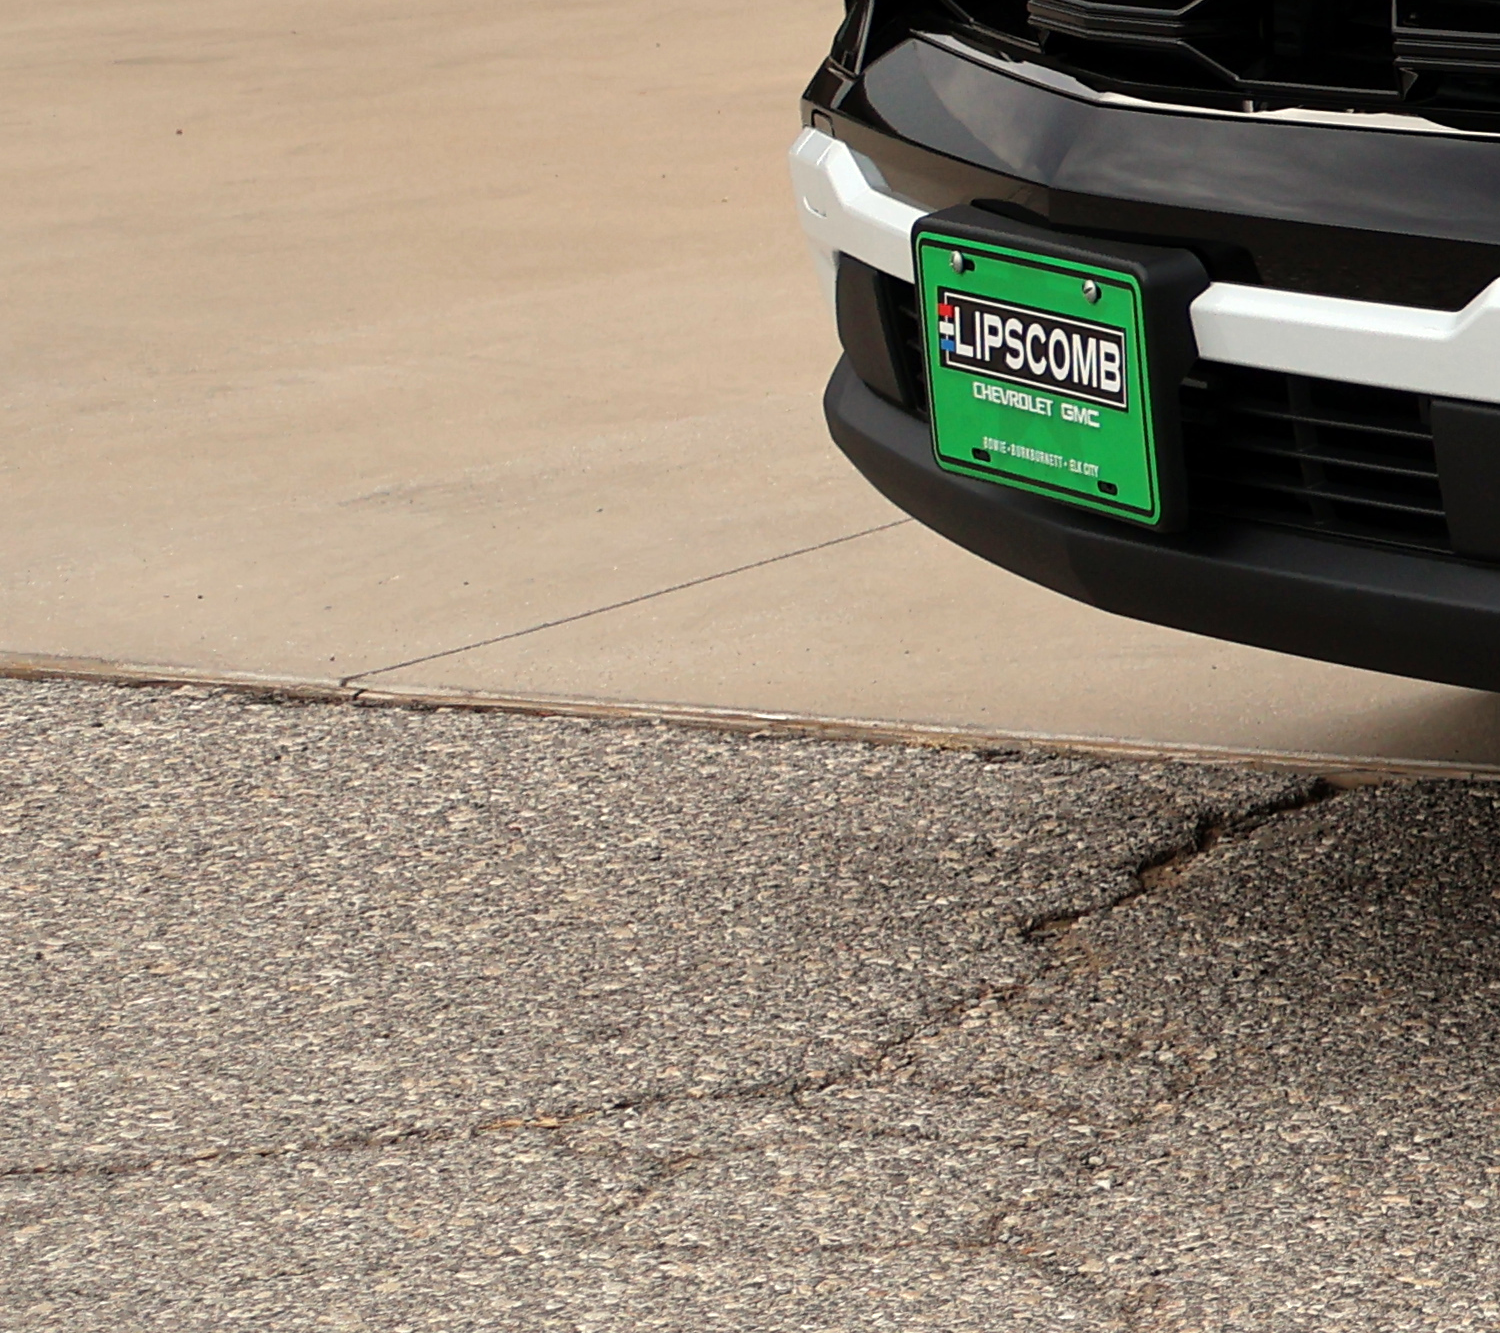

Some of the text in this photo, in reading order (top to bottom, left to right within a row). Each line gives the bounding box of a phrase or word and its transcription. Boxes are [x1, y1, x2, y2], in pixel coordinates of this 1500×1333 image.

[954, 306, 1121, 392] LIPSCOMB
[973, 382, 1100, 428] CHEVROLET GMC
